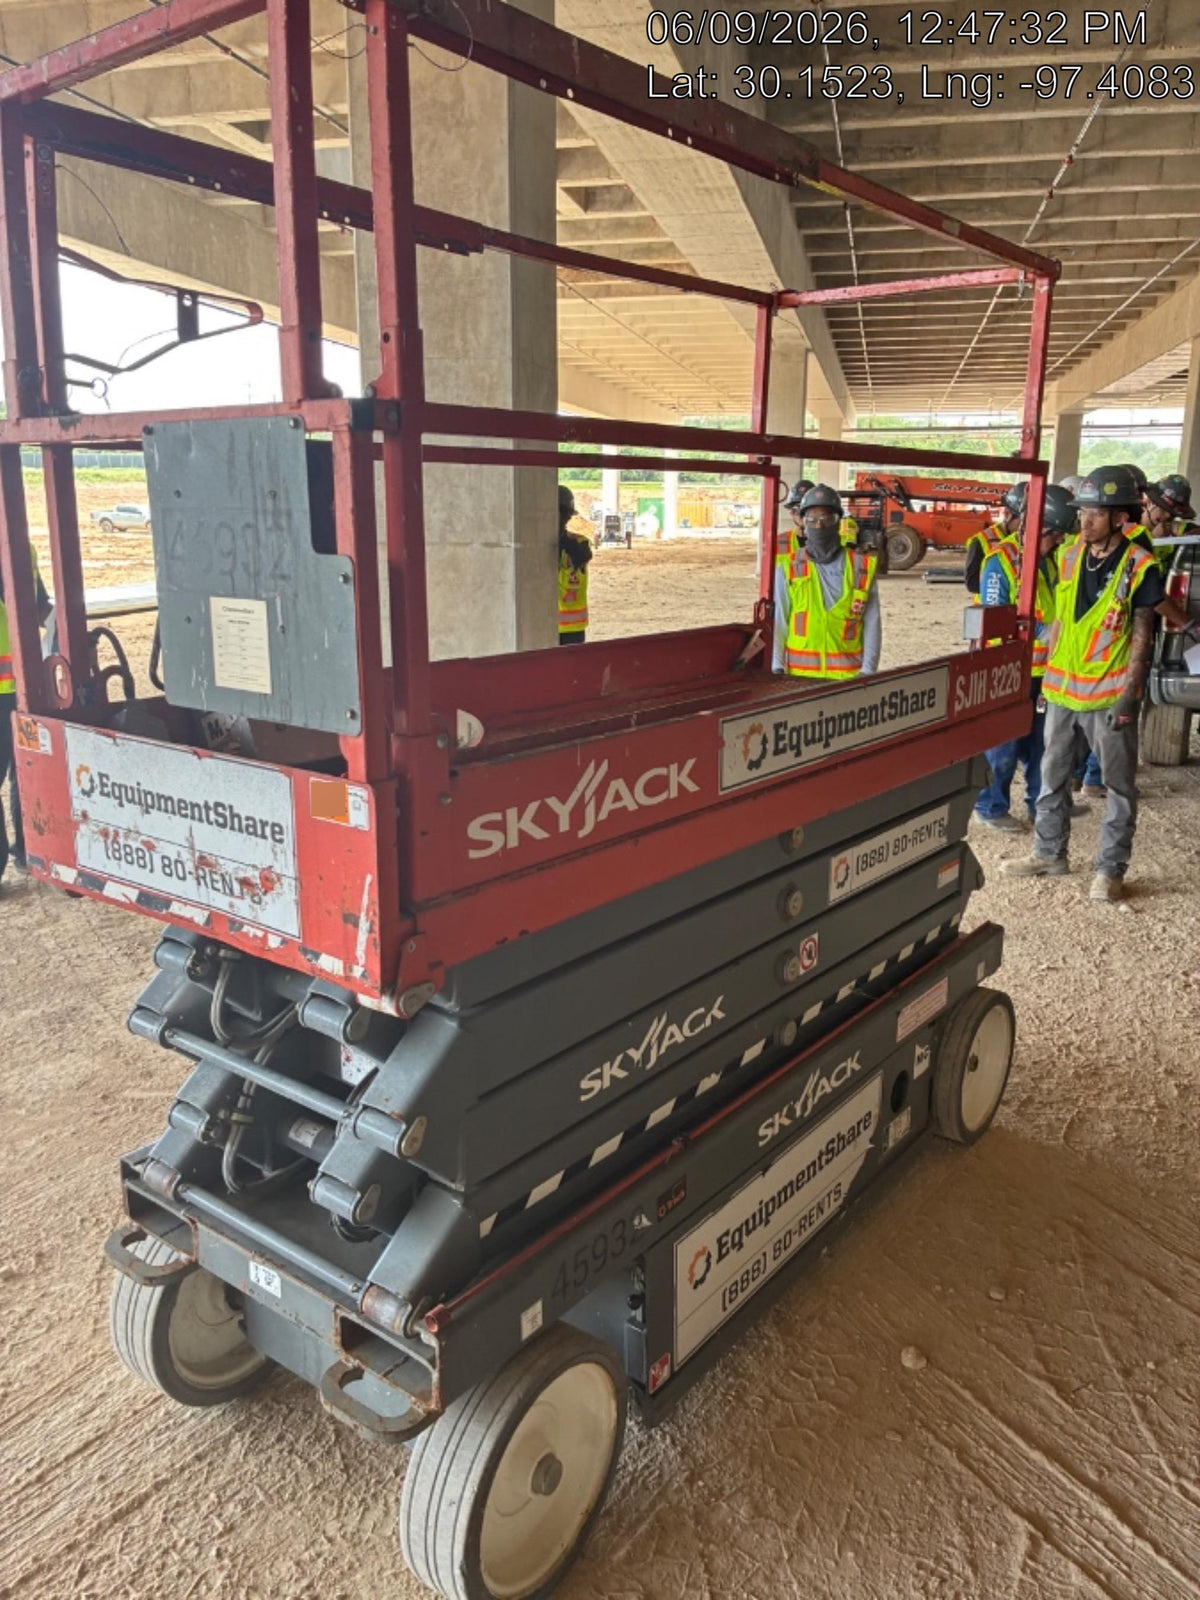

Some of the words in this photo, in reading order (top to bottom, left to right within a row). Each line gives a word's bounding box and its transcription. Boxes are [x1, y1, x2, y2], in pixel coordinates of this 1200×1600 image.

[771, 686, 936, 758] EquipmentShare
[989, 659, 1023, 700] 3226
[96, 770, 285, 845] EquipmentShare
[466, 756, 700, 860] SKYJACK
[103, 838, 155, 874] (888)
[855, 840, 890, 876] (888)
[579, 994, 727, 1102] SKYJACK
[758, 1050, 862, 1148] SKYJACK
[715, 1110, 873, 1265] EquipmentShare
[721, 1252, 768, 1313] (888)
[772, 1181, 843, 1262] 80-RENTS
